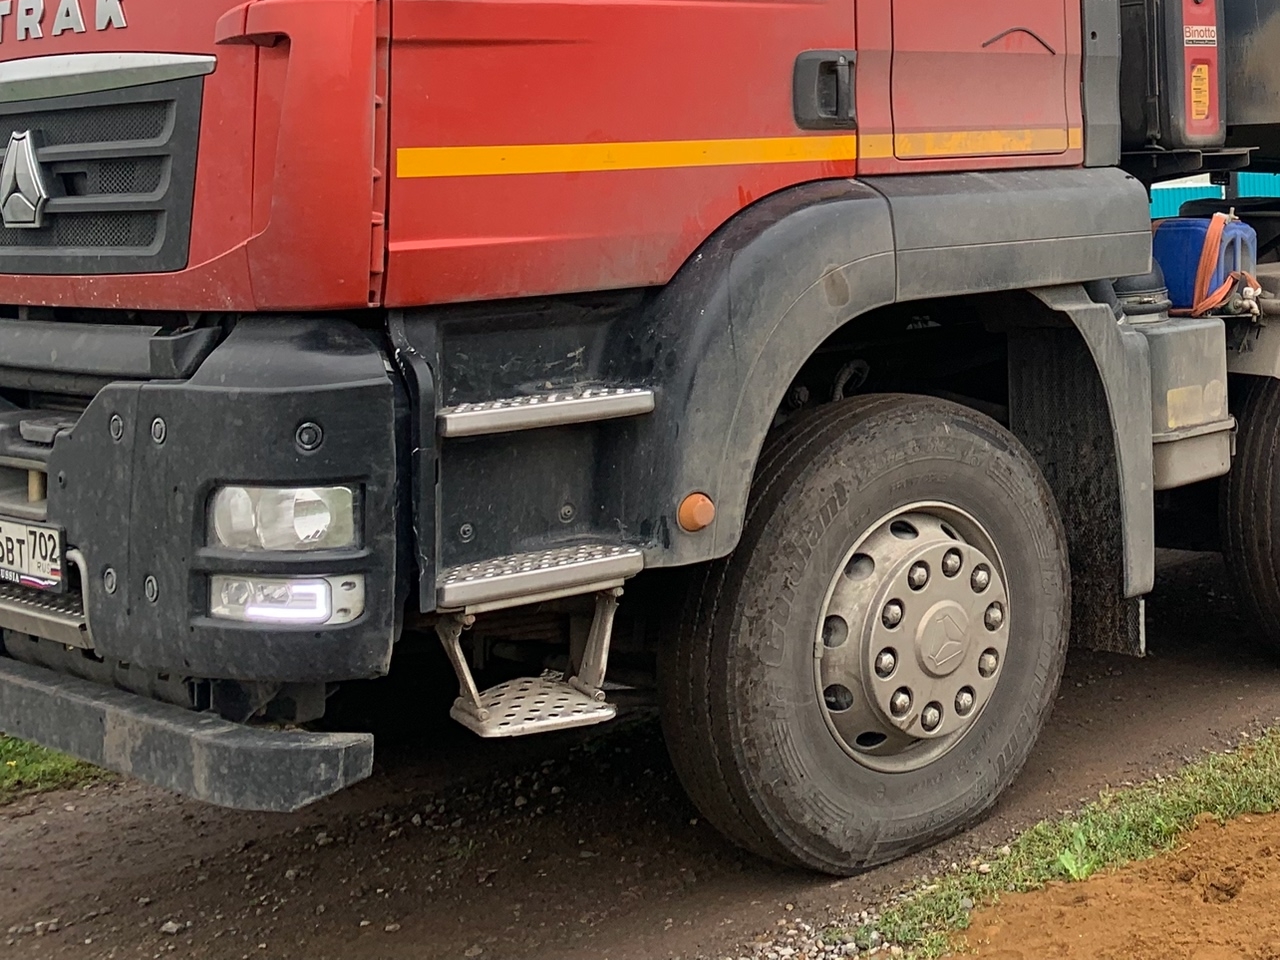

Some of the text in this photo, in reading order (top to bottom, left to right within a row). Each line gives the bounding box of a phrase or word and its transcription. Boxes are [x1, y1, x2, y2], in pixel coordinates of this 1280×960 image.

[1184, 26, 1216, 38] Binotto
[29, 530, 57, 563] 702
[37, 561, 51, 574] RUS
